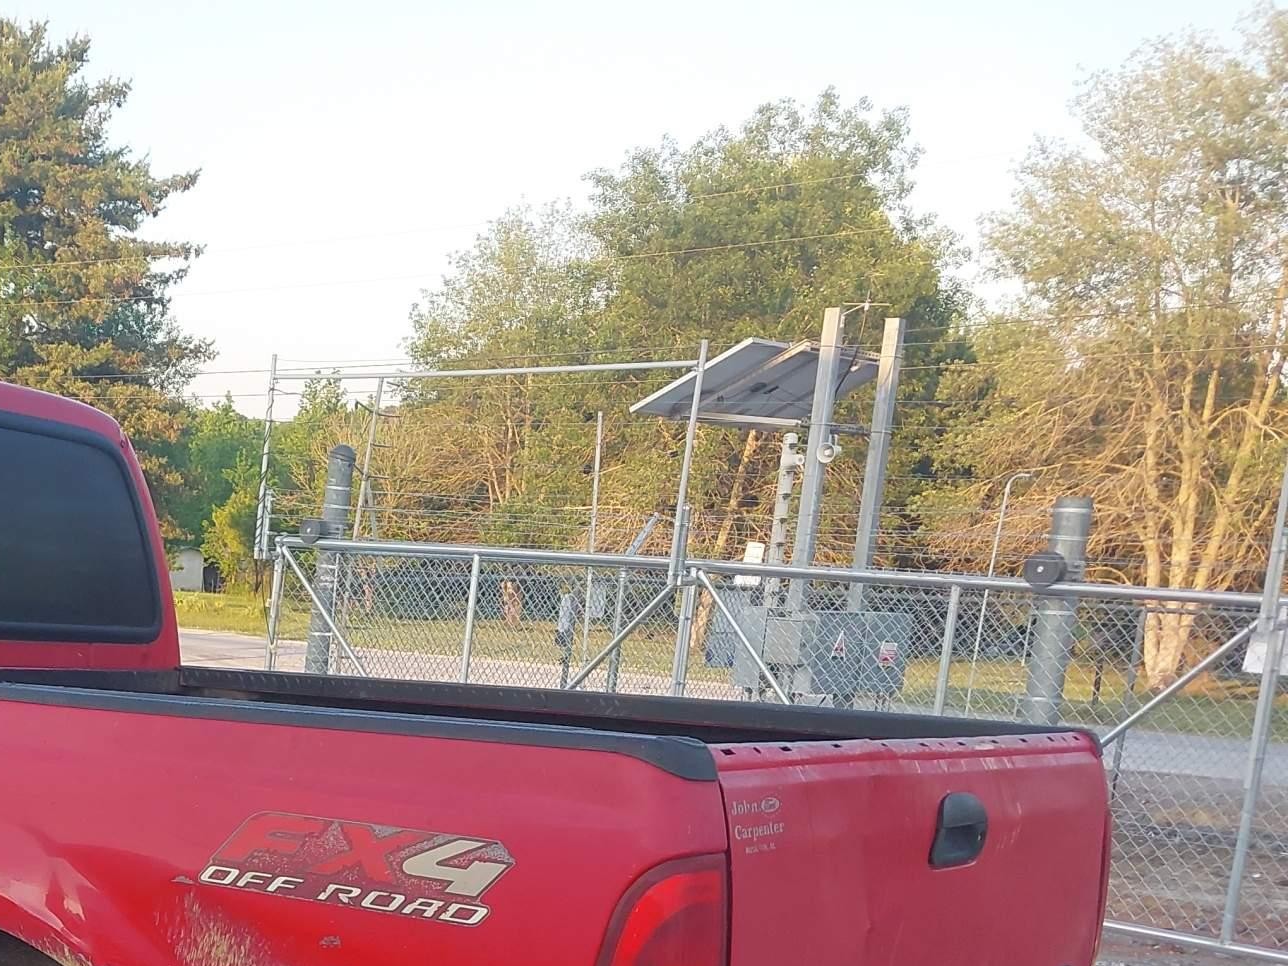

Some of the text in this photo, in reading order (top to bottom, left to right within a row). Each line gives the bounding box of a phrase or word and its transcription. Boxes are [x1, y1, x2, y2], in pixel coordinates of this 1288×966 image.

[732, 799, 759, 816] John
[735, 821, 785, 841] Carpenter
[211, 812, 513, 898] FX4
[200, 865, 490, 926] OFF ROAD
